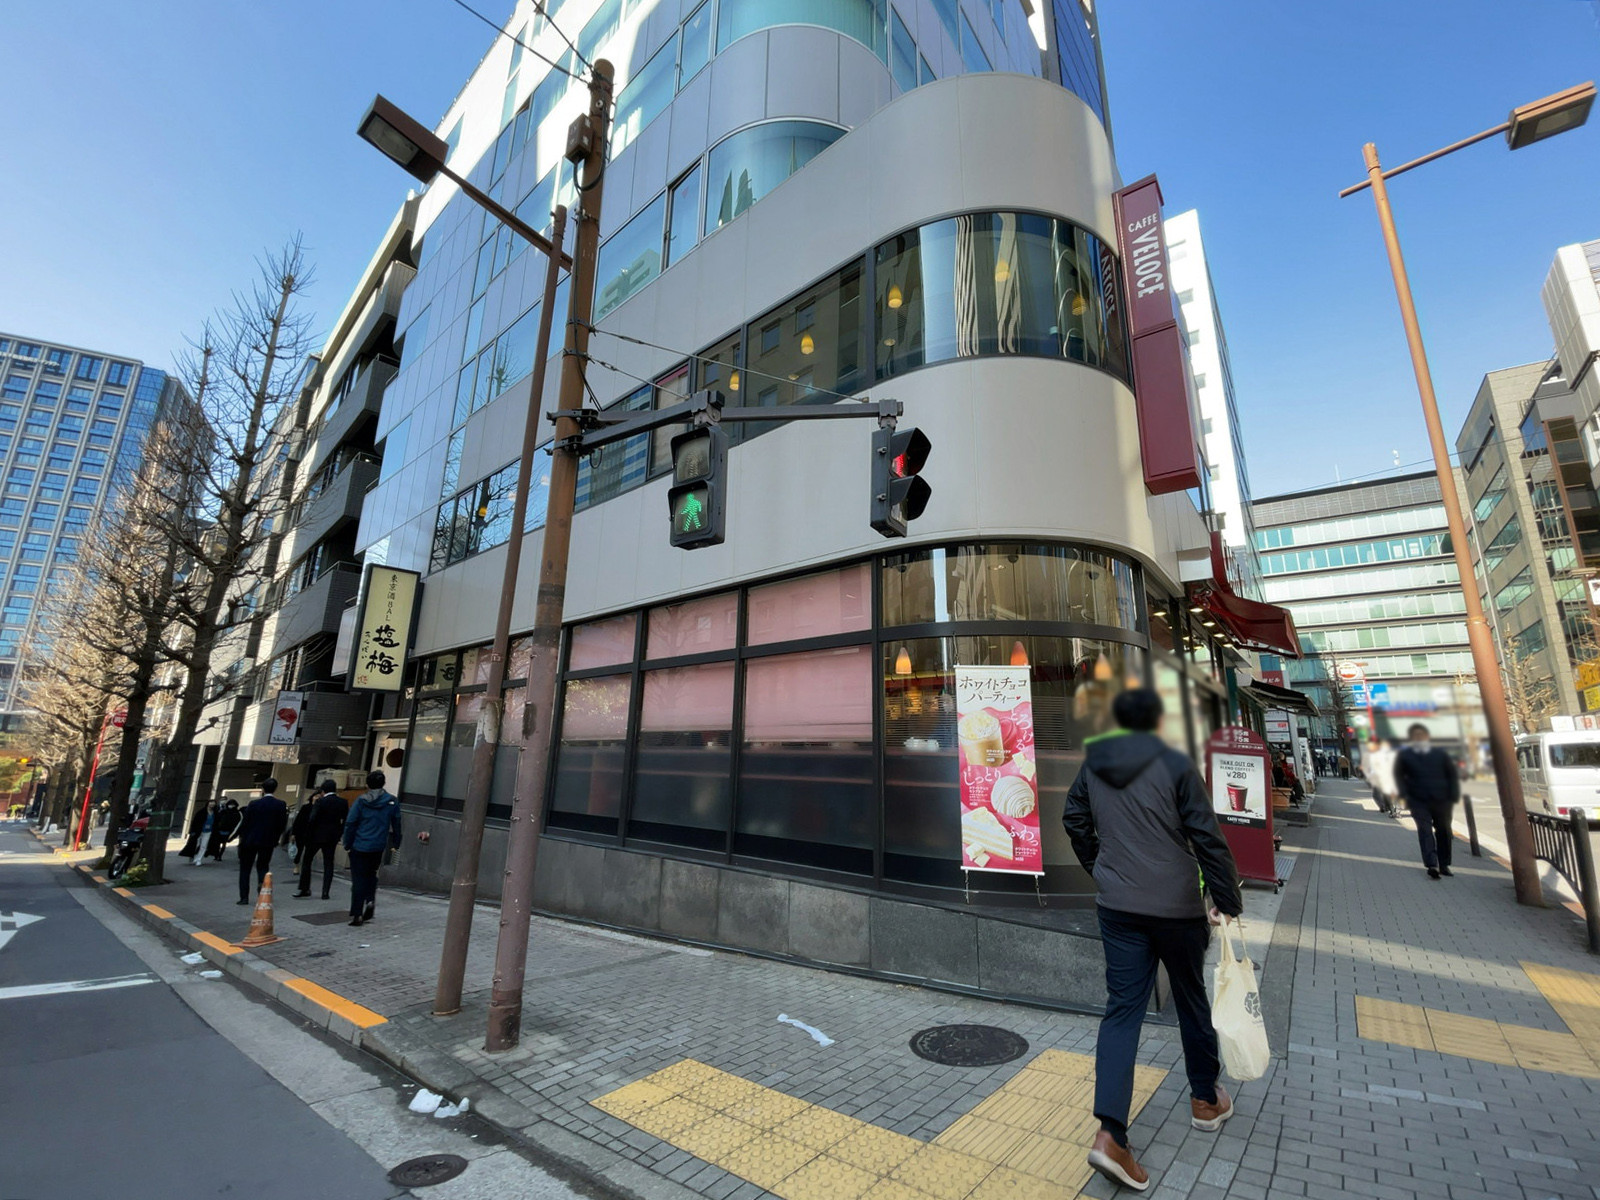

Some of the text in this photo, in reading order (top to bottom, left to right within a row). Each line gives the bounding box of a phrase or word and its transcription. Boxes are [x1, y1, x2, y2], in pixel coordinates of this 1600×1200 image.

[1128, 213, 1158, 233] CAFFE
[1132, 227, 1164, 298] VELOCE
[959, 676, 1027, 691] ホワイトチョコ
[963, 690, 1015, 704] パーティー
[963, 766, 1001, 786] しっとり
